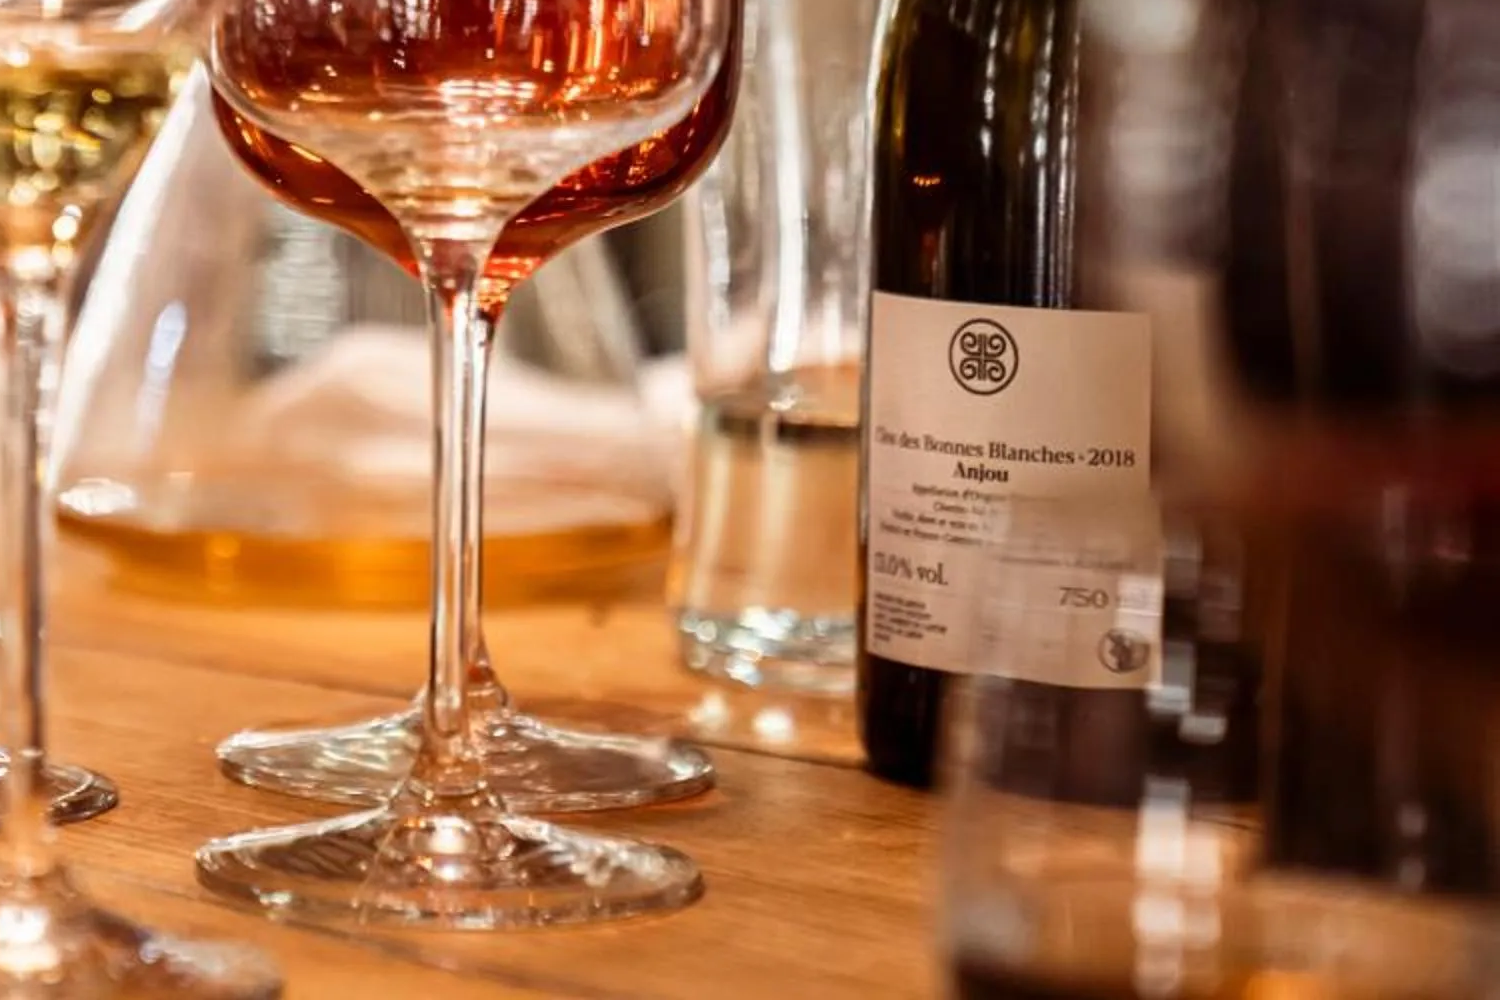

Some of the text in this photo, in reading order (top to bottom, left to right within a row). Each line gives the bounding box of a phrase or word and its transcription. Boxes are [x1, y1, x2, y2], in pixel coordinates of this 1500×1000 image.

[923, 433, 984, 457] Bonnes
[988, 441, 1075, 465] Blanches
[1088, 447, 1136, 468] 2018
[953, 461, 1009, 484] Anjou
[917, 562, 949, 586] vol.
[1059, 586, 1109, 609] 750
